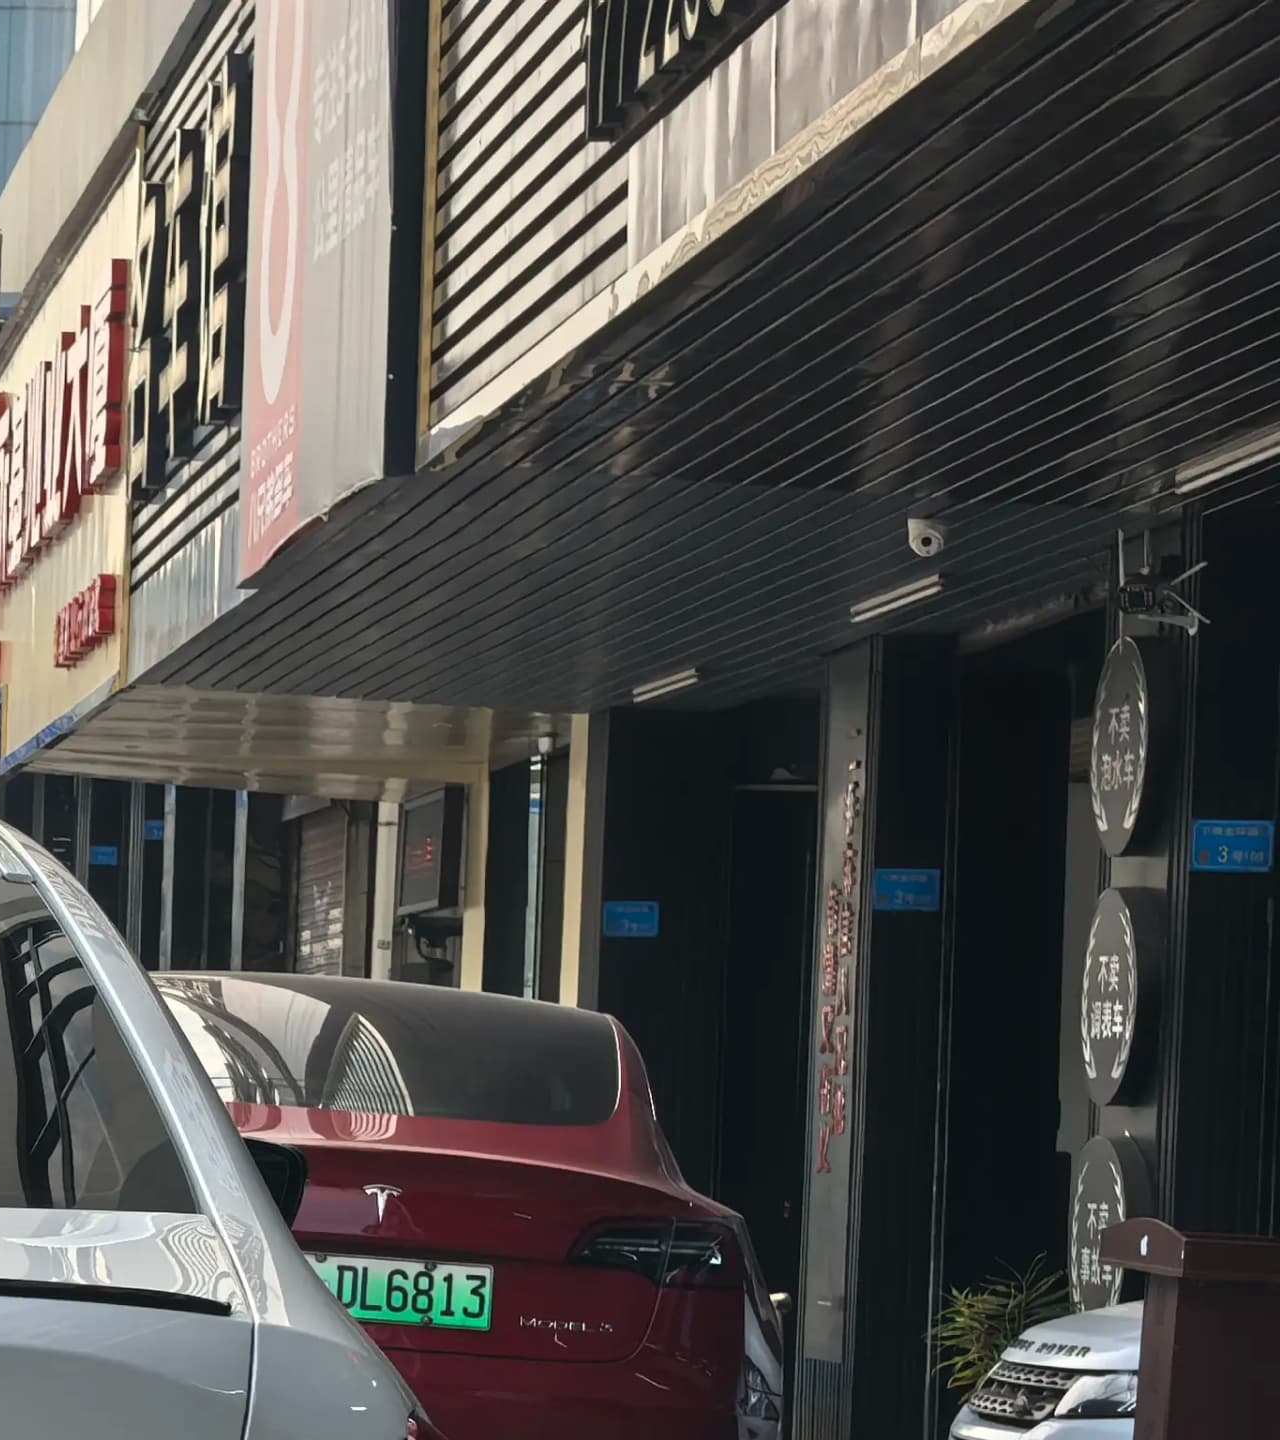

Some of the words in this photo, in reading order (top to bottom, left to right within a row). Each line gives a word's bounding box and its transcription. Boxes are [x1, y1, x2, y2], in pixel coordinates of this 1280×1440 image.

[1108, 704, 1131, 745] 不卖
[1100, 749, 1135, 791] 泡水车
[1097, 953, 1120, 993] 不卖
[337, 1264, 487, 1319] DL6813
